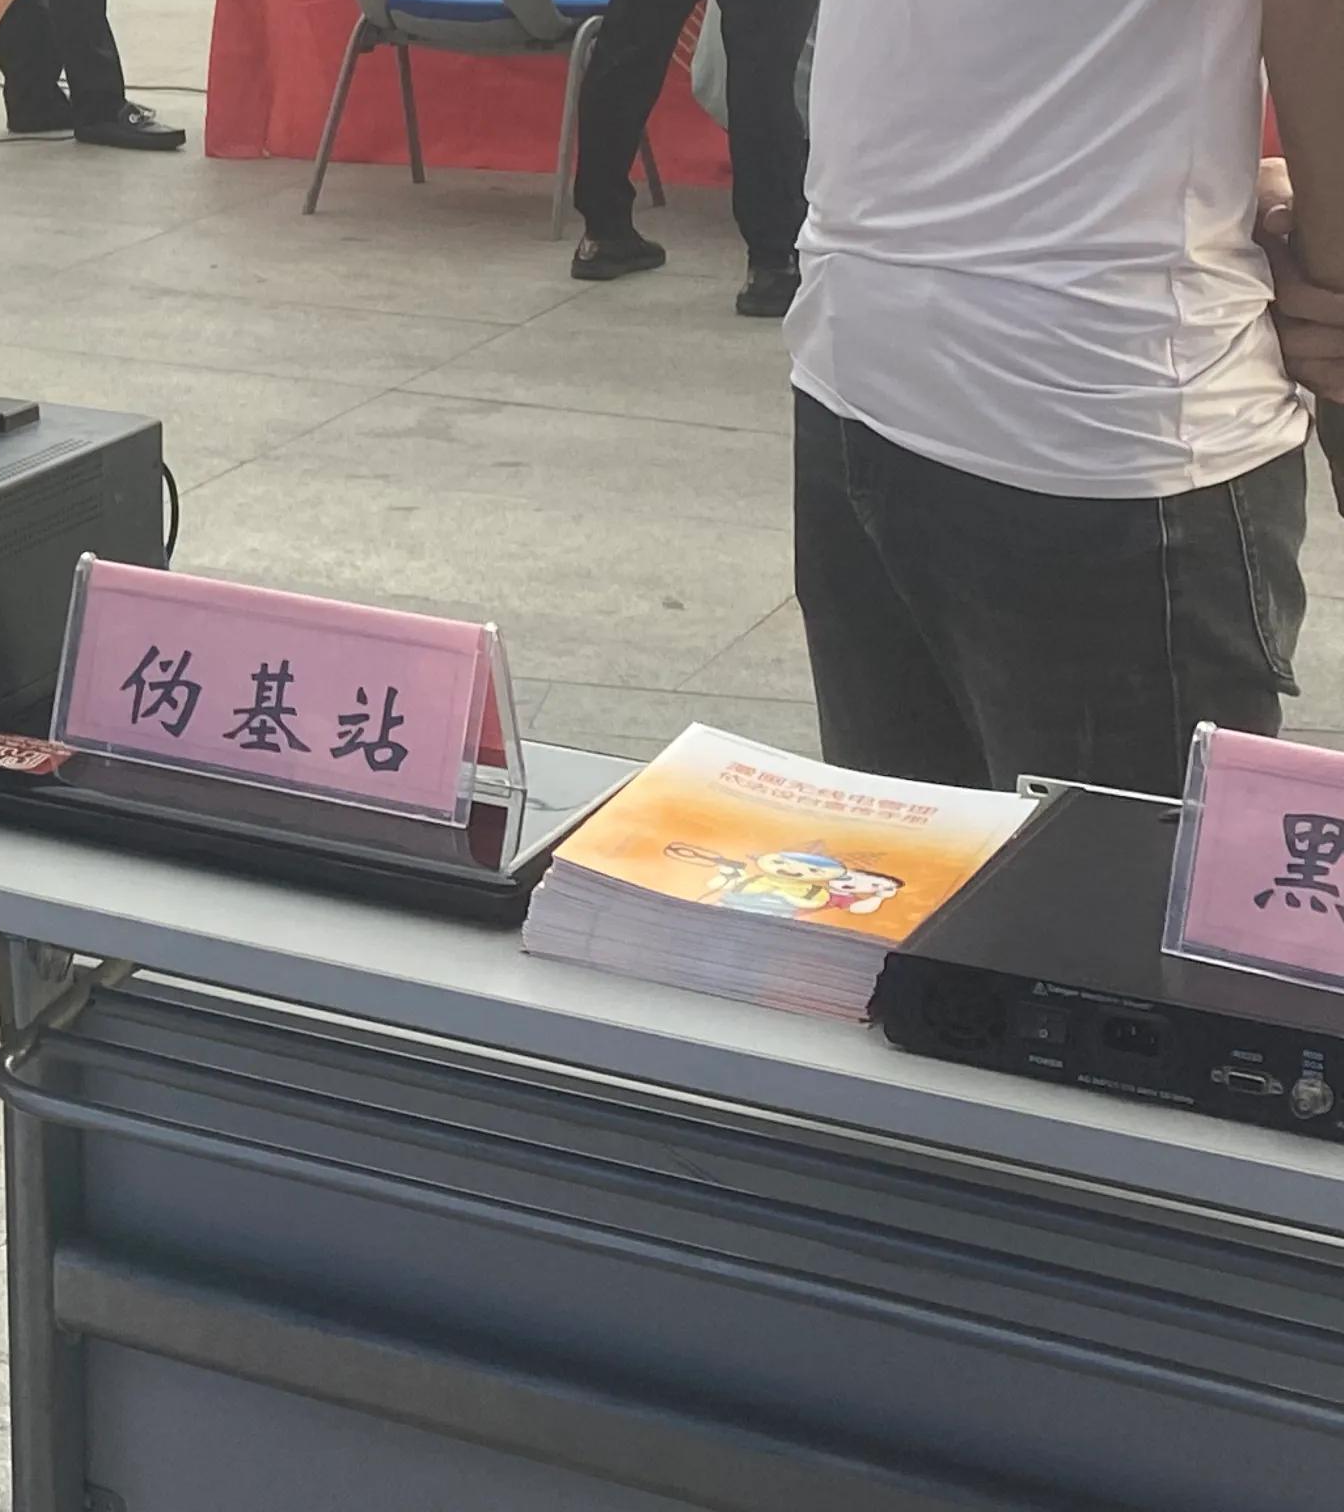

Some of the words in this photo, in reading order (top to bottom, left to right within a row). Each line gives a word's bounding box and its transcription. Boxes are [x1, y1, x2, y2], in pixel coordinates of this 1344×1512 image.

[119, 644, 409, 773] 伪基站
[1253, 813, 1344, 924] 黑
